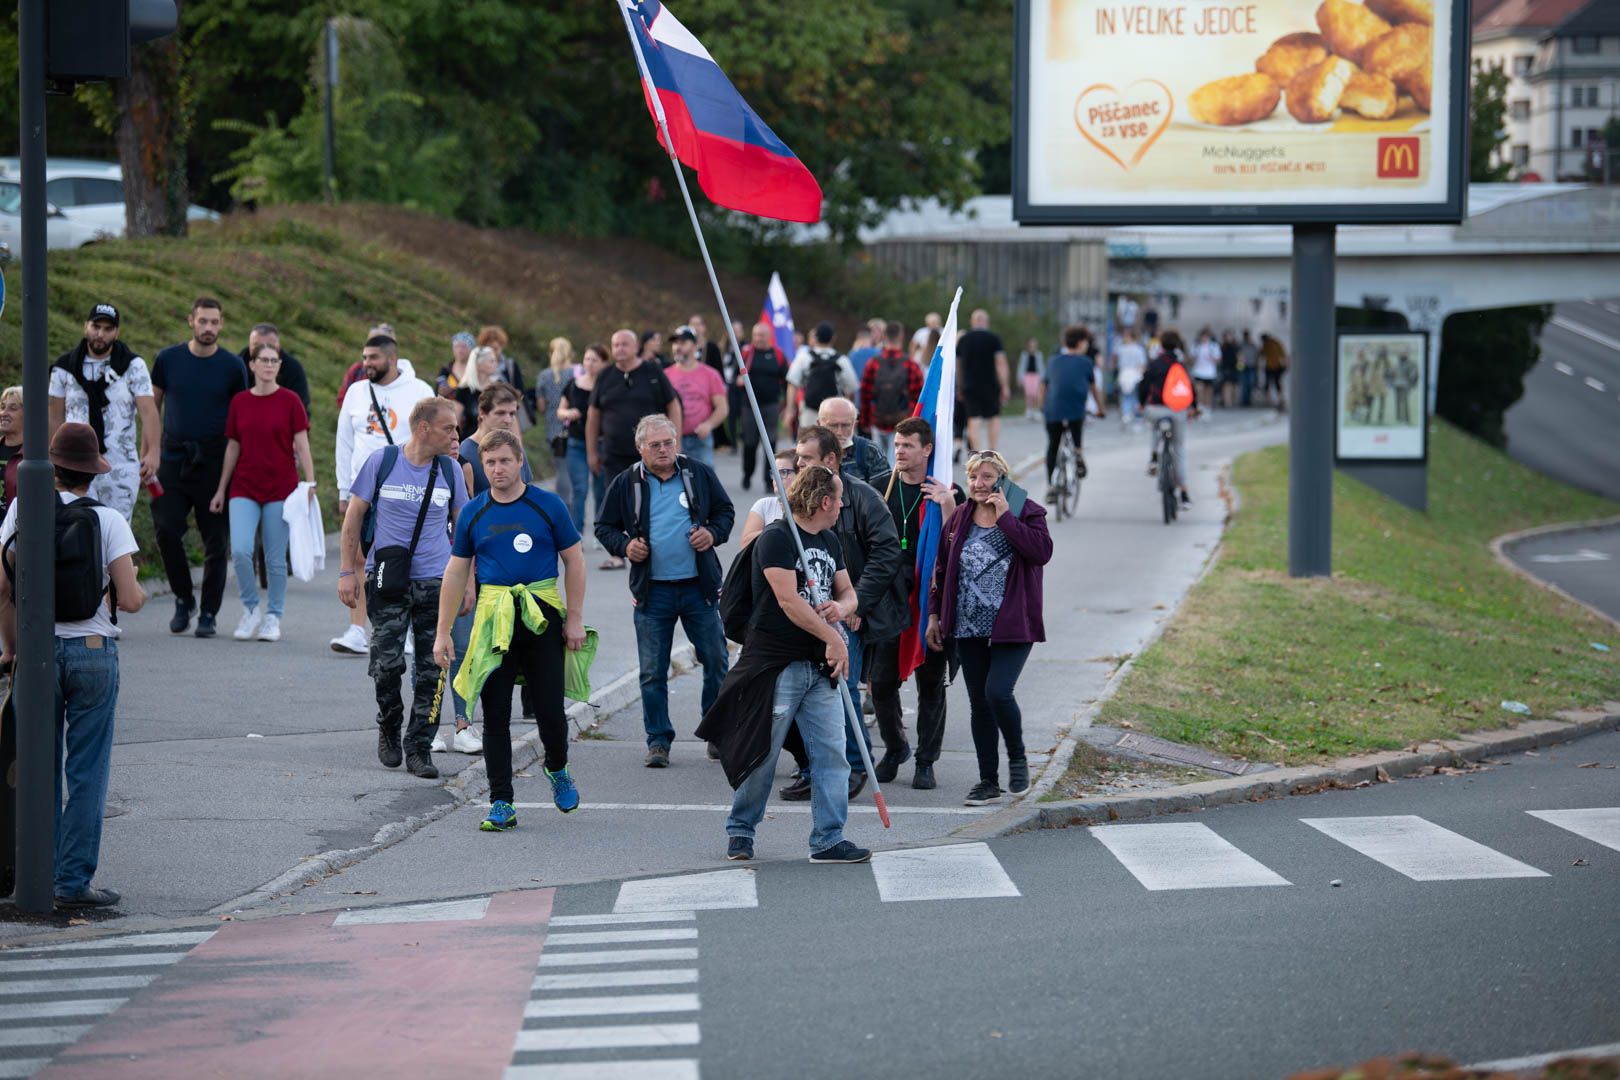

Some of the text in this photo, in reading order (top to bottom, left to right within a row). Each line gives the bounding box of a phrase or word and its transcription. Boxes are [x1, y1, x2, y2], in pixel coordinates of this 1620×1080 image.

[1096, 5, 1257, 36] IN VELIKE JEDCE
[1088, 100, 1161, 125] Piščanec
[1102, 121, 1148, 139] za vse
[1201, 145, 1286, 161] McNuggets
[402, 483, 427, 495] VENIC
